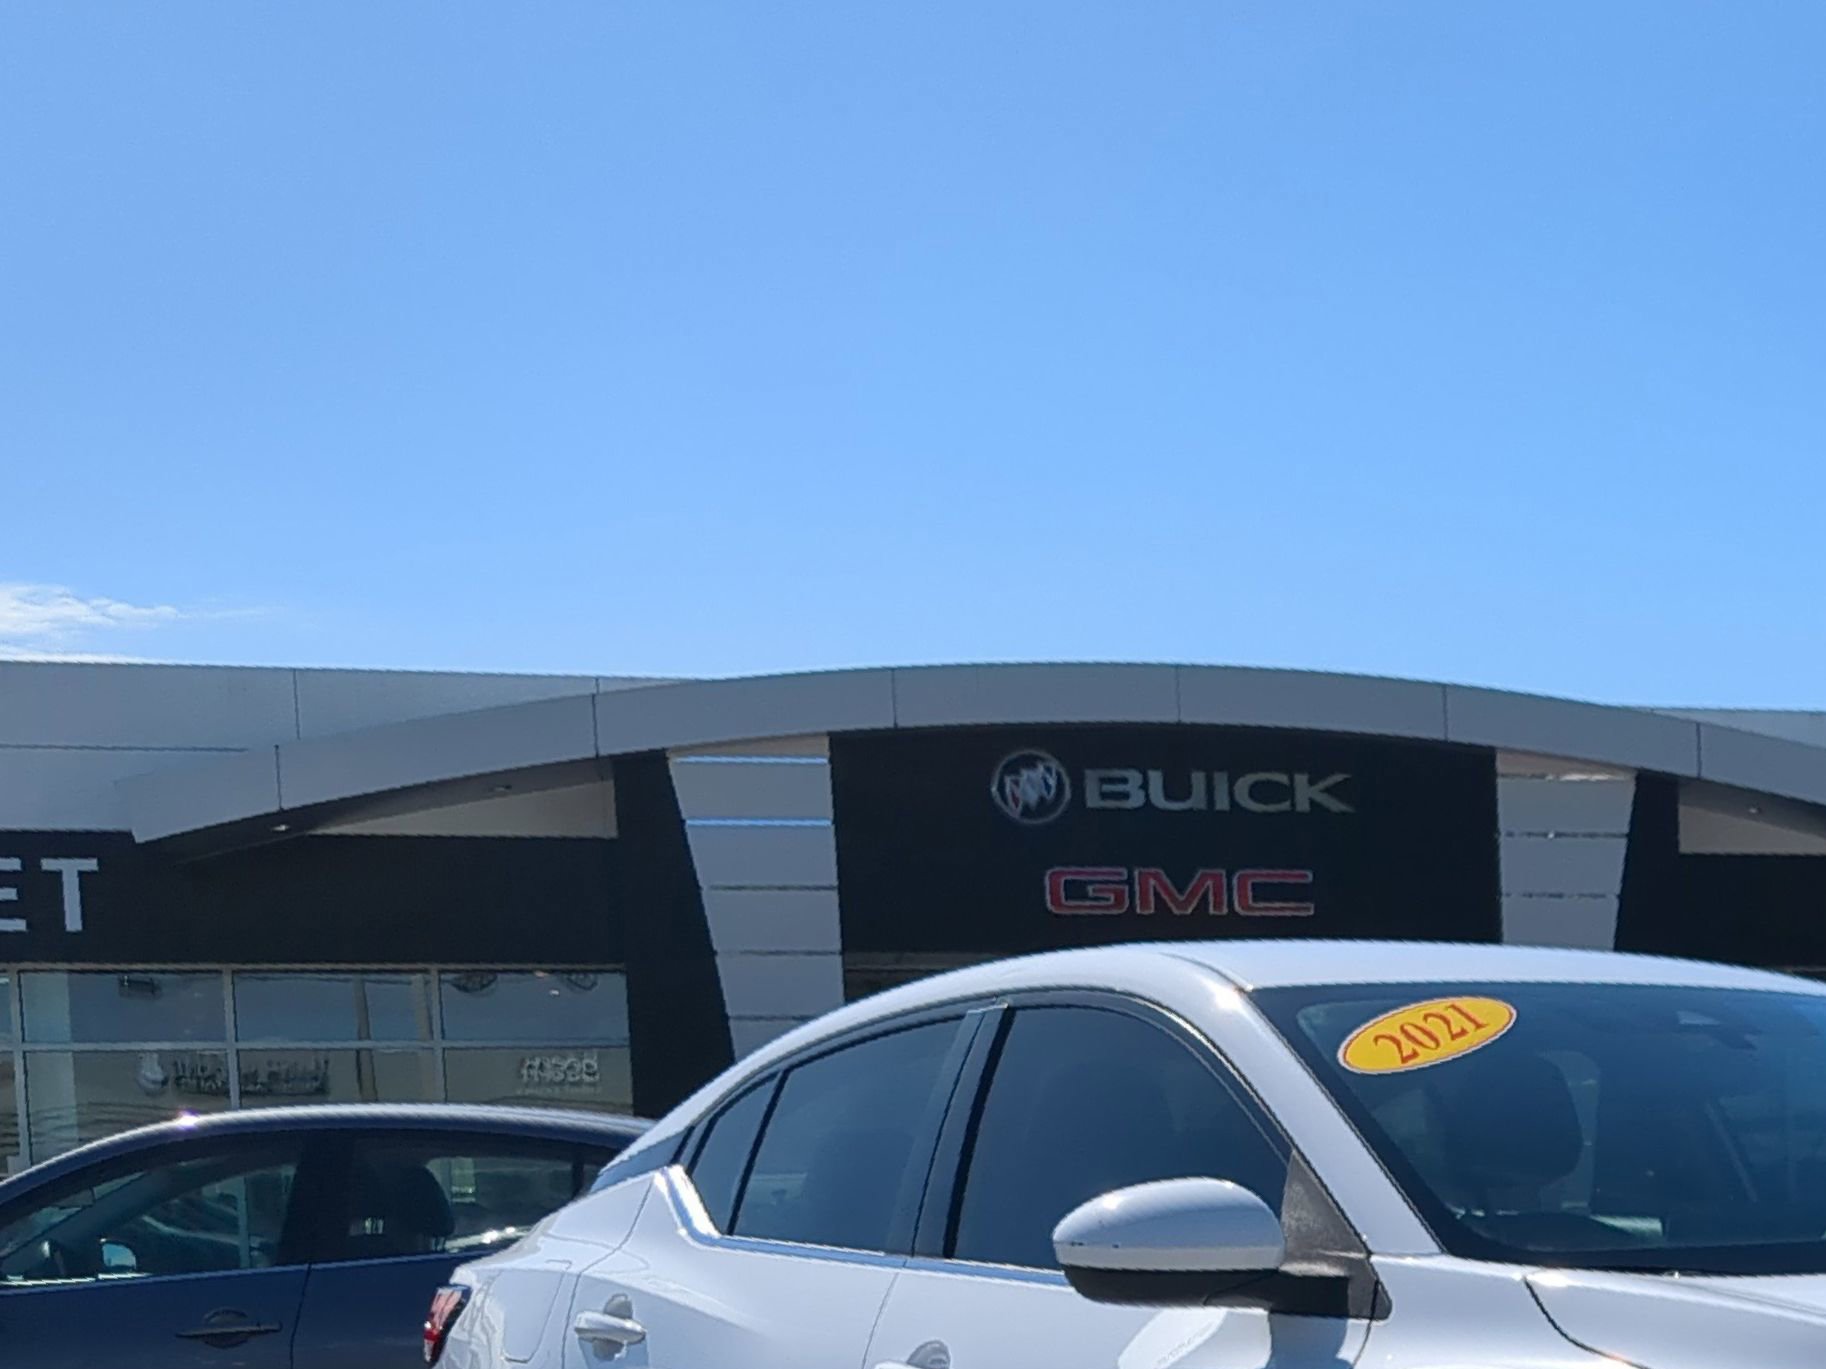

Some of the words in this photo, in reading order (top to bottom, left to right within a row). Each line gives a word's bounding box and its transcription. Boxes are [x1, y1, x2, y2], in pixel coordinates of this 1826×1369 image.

[1085, 769, 1354, 812] BUICK
[1047, 867, 1314, 916] GMC
[1373, 1003, 1488, 1063] 2021
